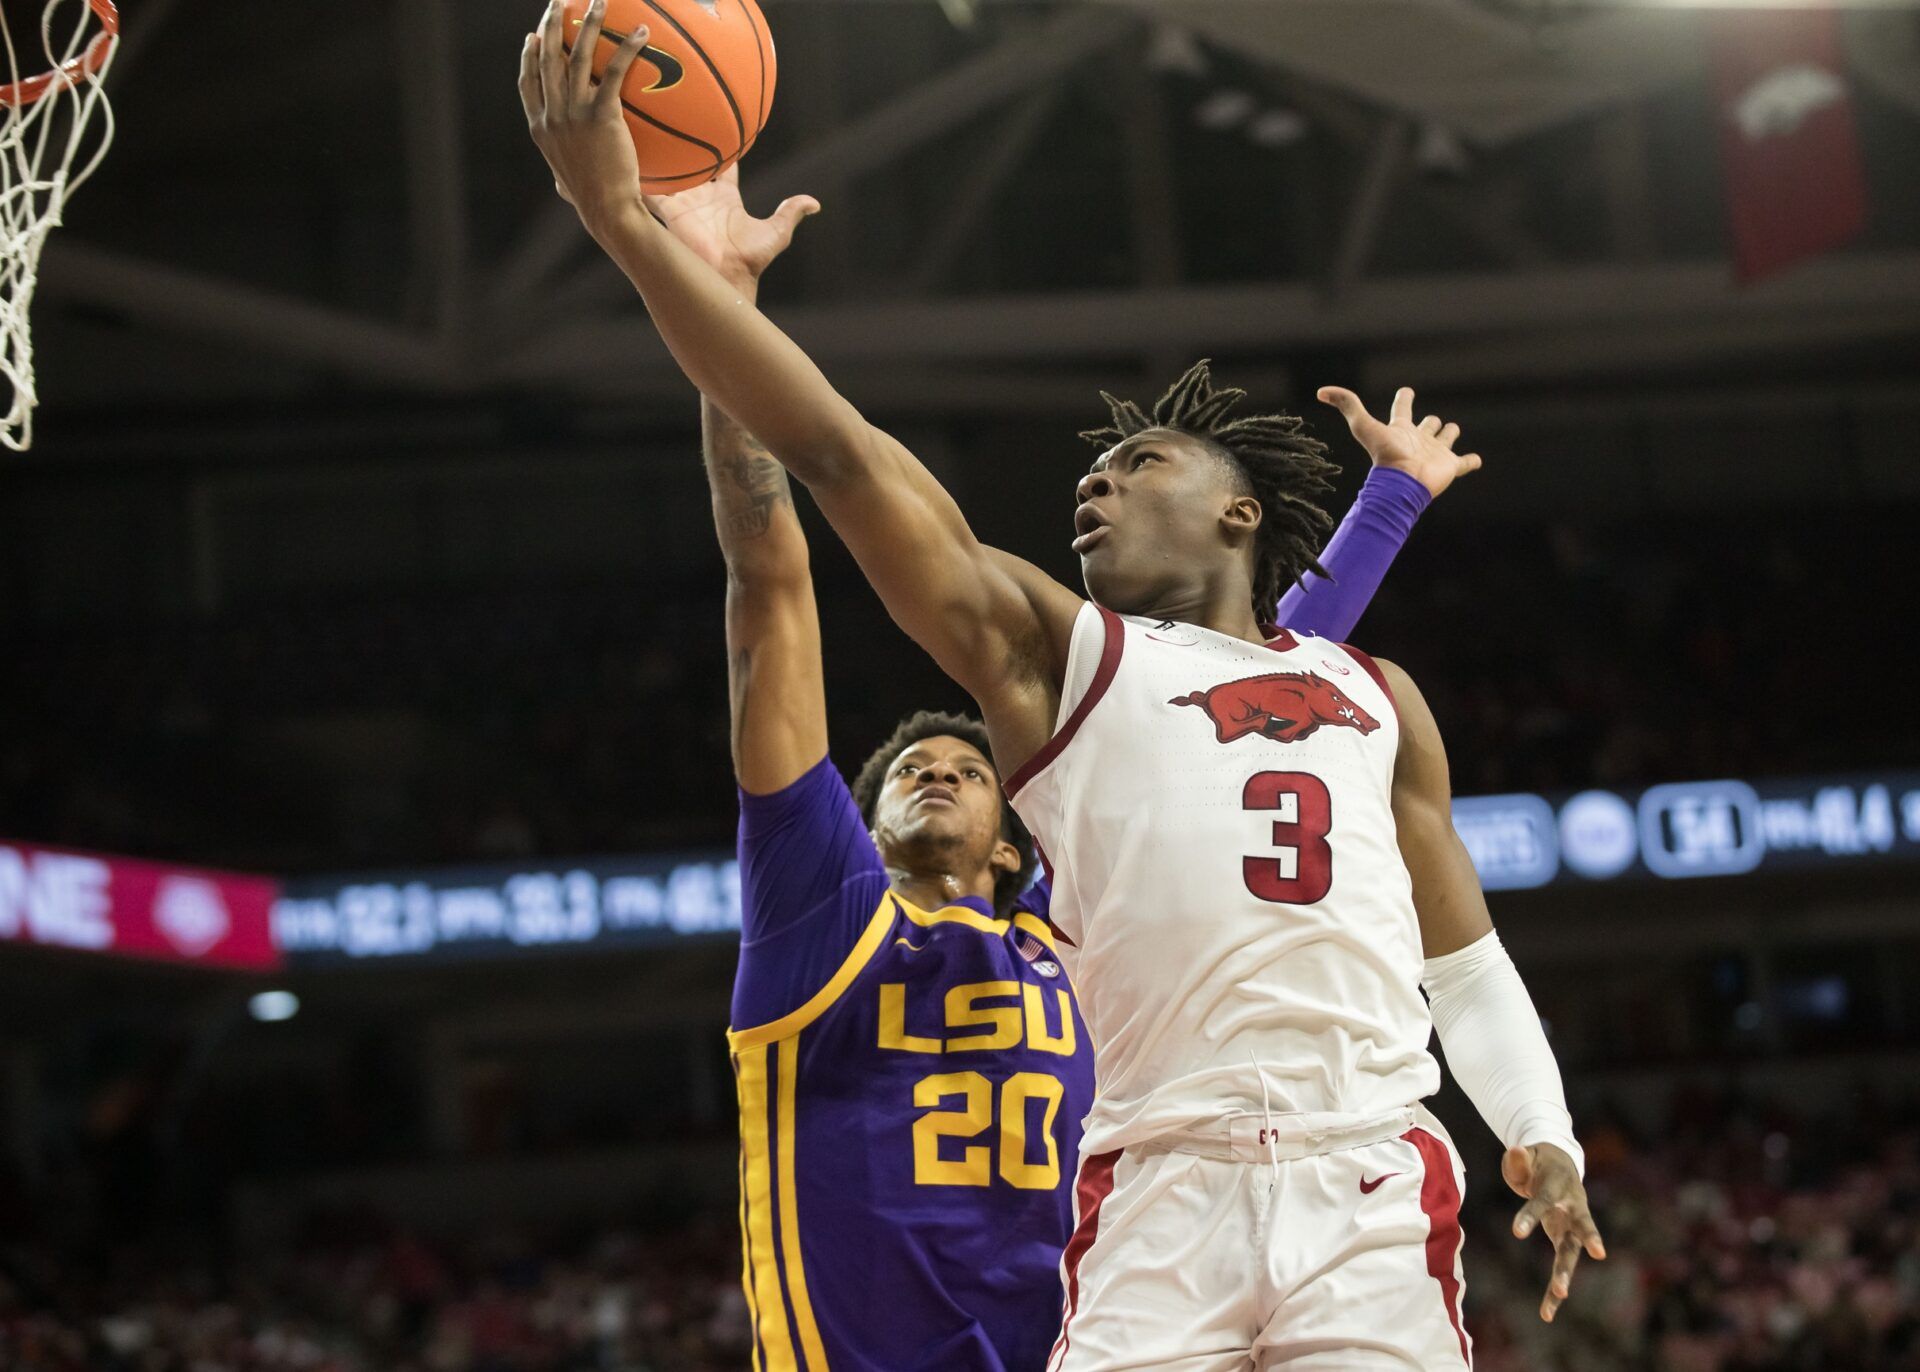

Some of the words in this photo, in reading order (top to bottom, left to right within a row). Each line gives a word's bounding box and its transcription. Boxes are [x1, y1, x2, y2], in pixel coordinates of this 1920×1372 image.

[1242, 770, 1332, 905] 3
[877, 980, 1076, 1057] LSU
[912, 1070, 1065, 1190] 20
